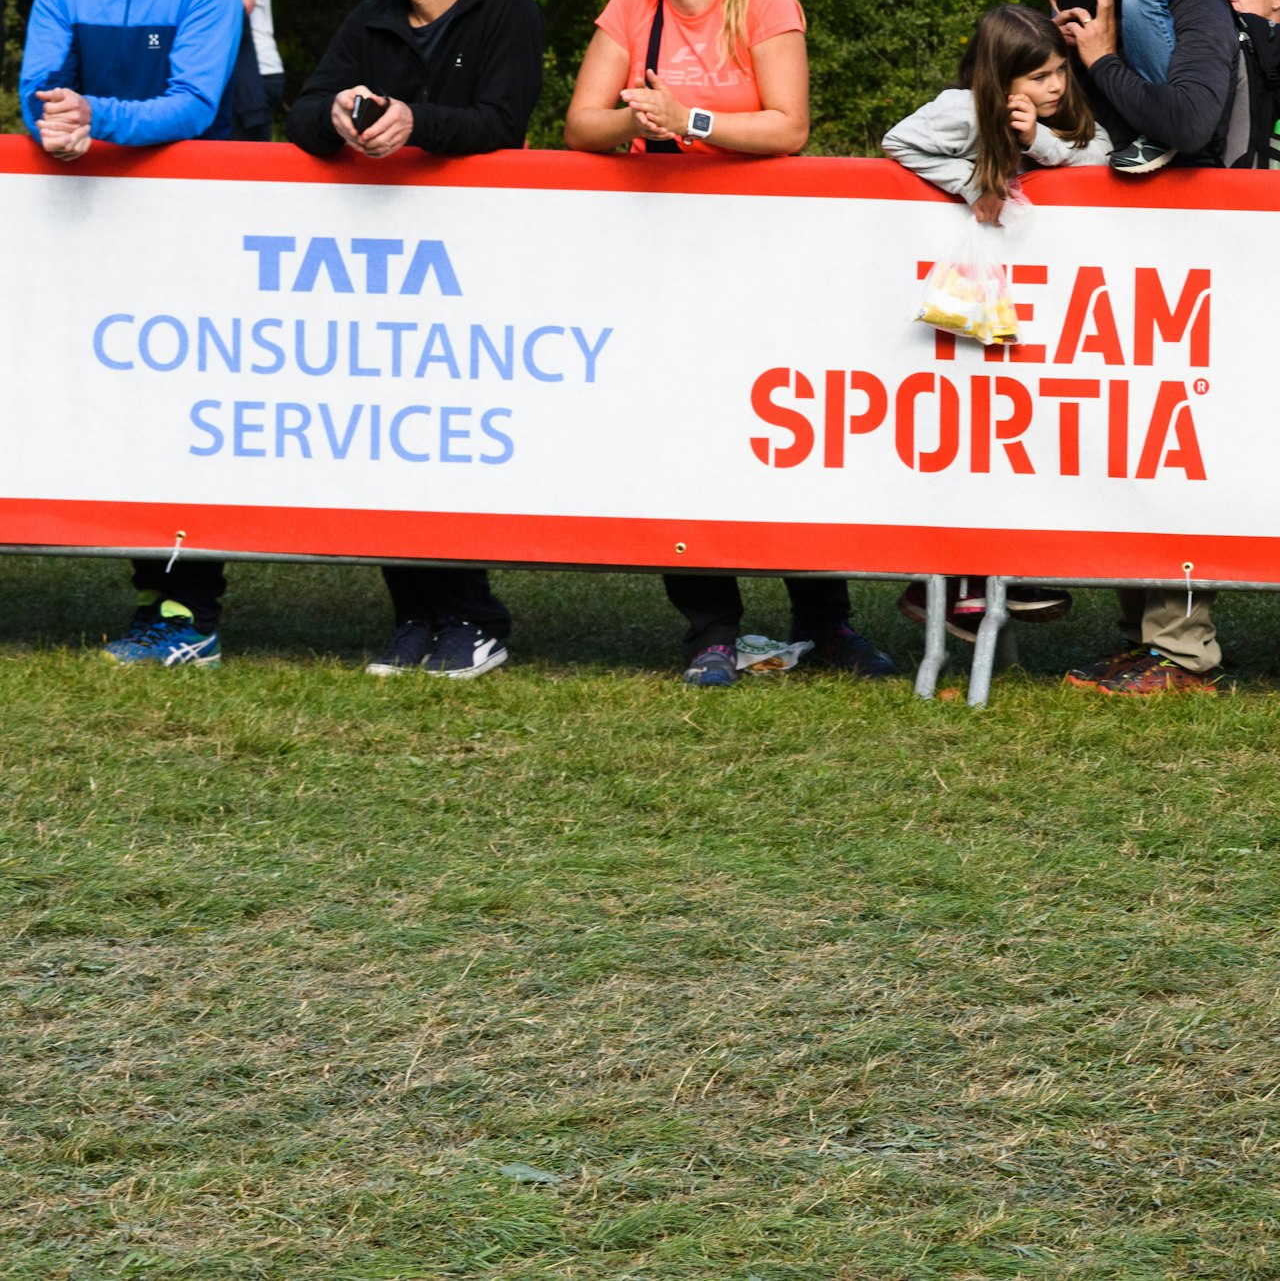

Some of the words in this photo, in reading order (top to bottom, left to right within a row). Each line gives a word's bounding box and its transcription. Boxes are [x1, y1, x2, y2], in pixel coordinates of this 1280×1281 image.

[243, 235, 463, 296] TATA
[93, 313, 613, 383] CONSULTANCY
[190, 399, 514, 465] SERVICES
